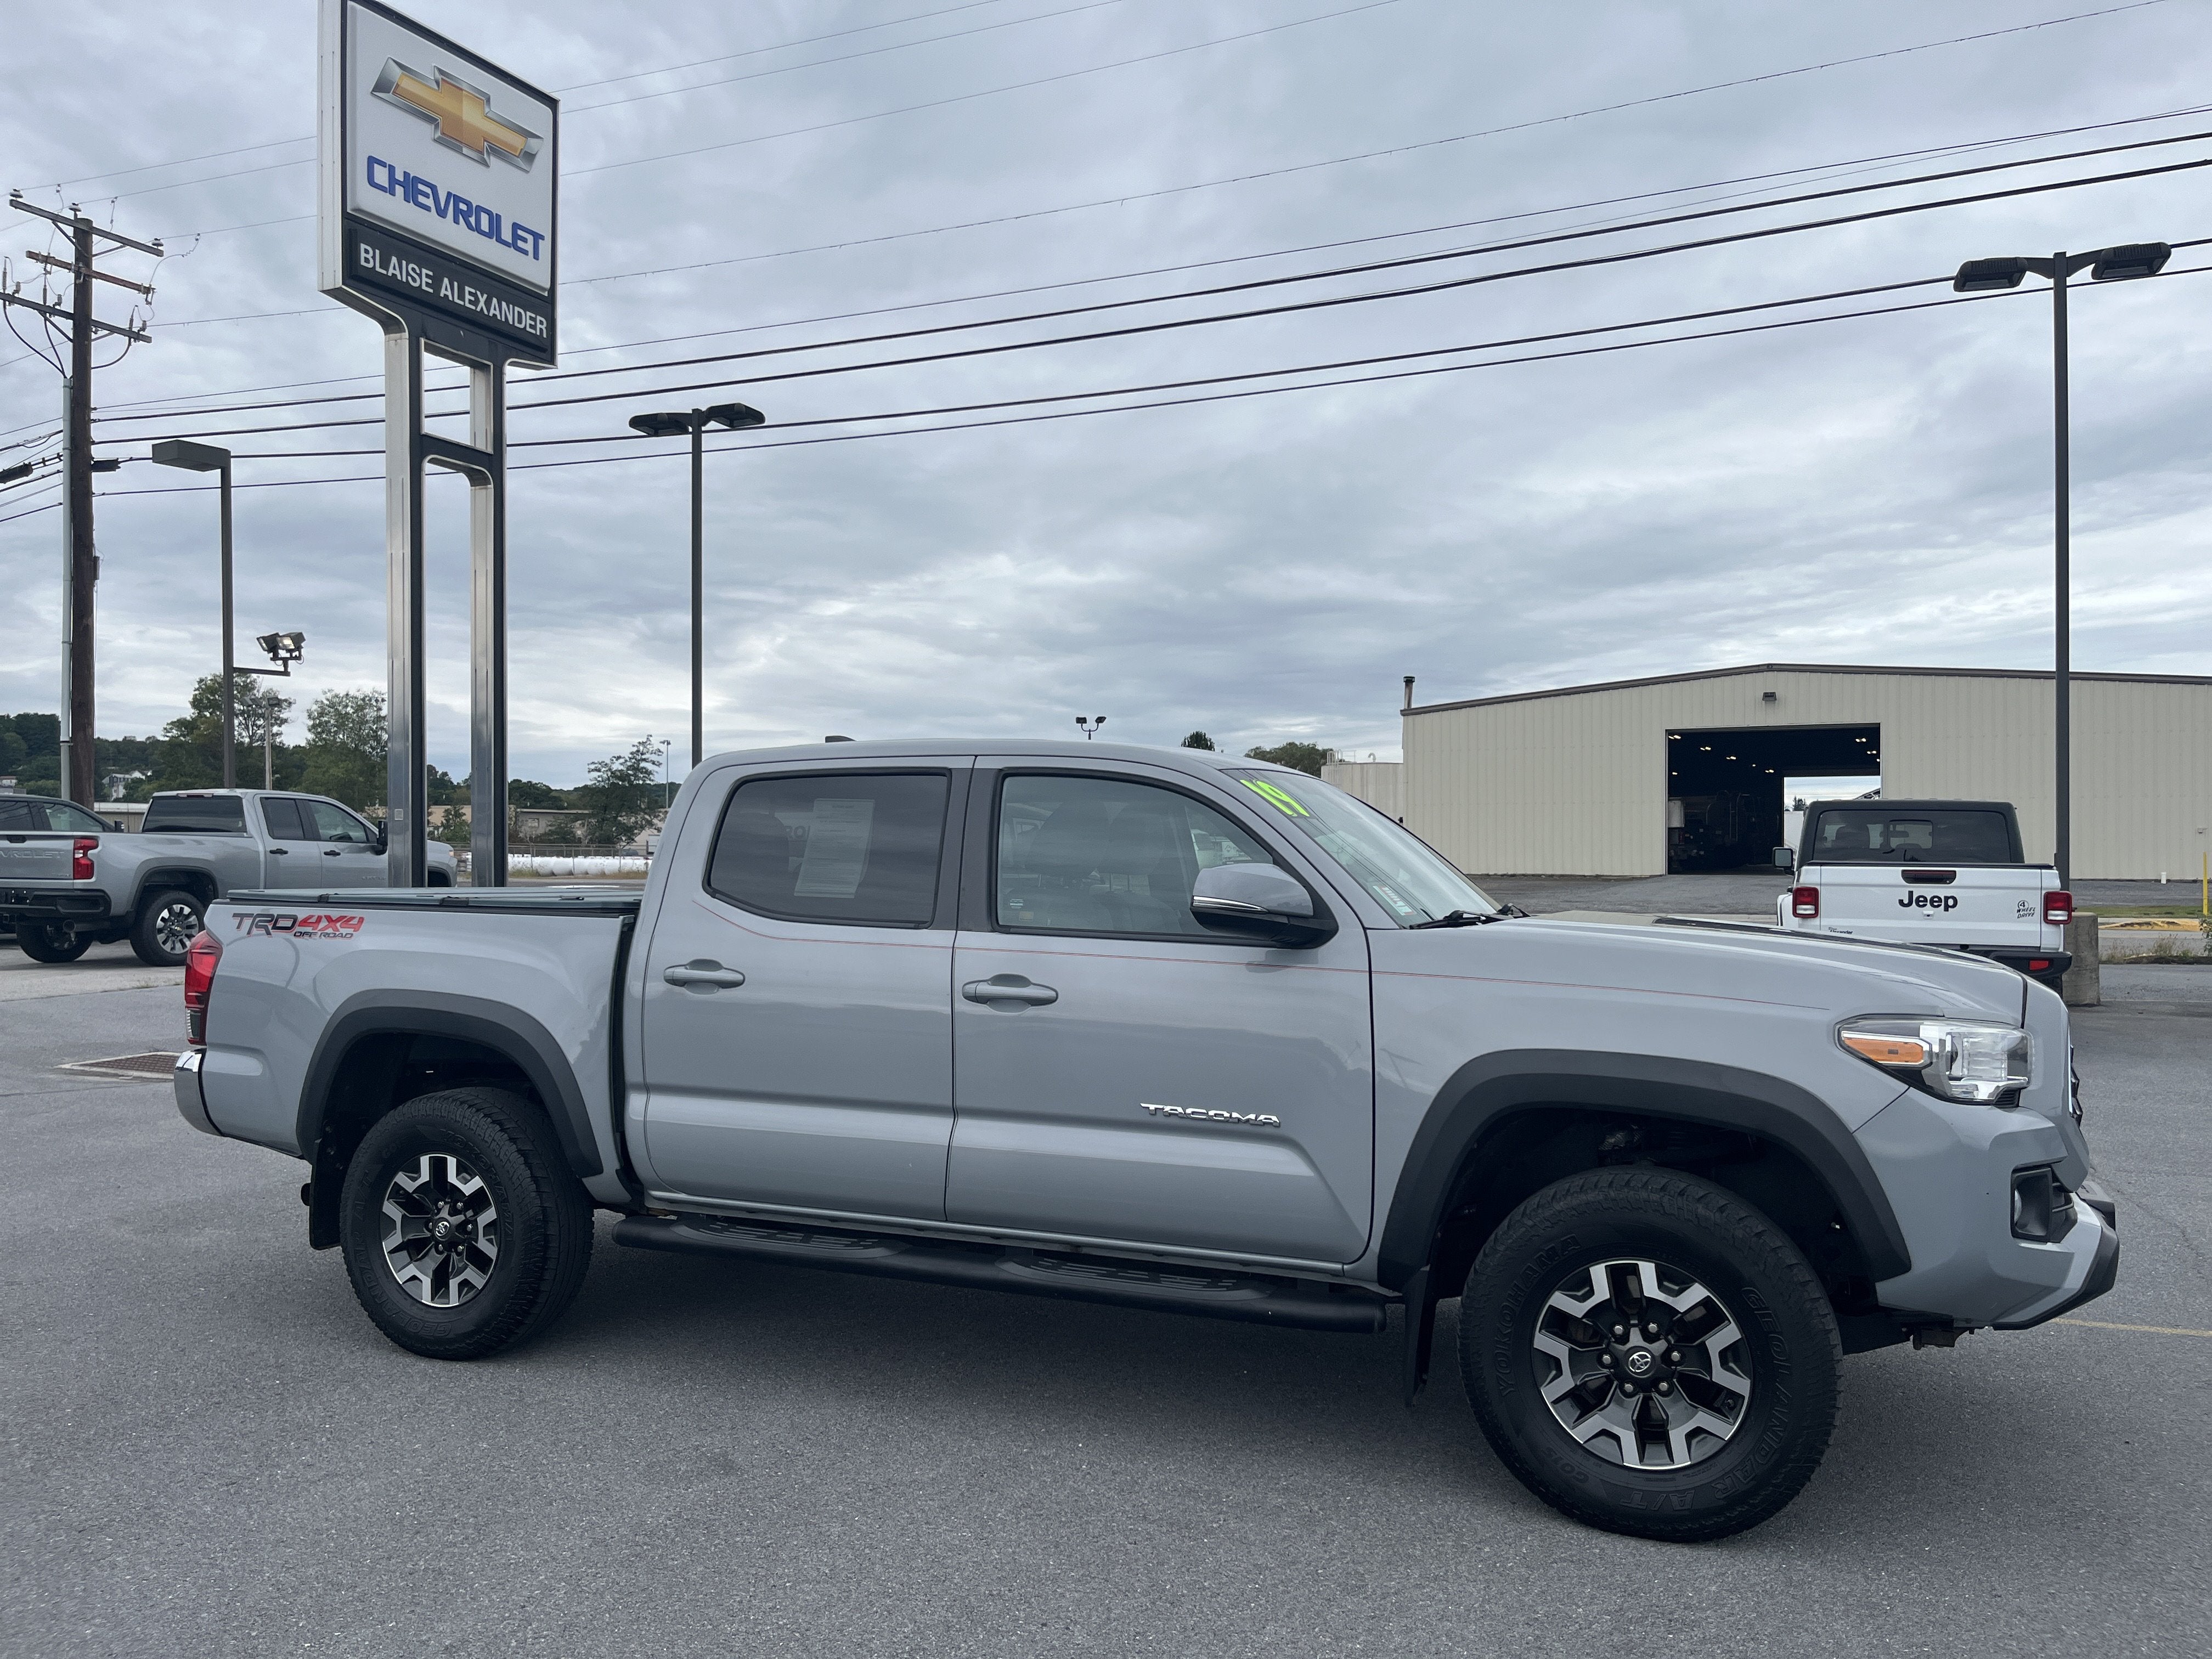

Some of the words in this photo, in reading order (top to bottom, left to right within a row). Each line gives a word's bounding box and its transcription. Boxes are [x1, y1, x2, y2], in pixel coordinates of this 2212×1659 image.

[367, 155, 545, 260] CHEVROLET
[360, 243, 434, 294] BLAISE
[440, 277, 547, 338] ALEXANDER
[1240, 780, 1310, 817] 19
[1898, 890, 1958, 912] Jeep
[1140, 1103, 1280, 1127] TACOMA
[1493, 1234, 1581, 1397] YOKOHAMA
[1714, 1286, 1792, 1501] GEOLANDAR
[1619, 1489, 1695, 1511] A/T
